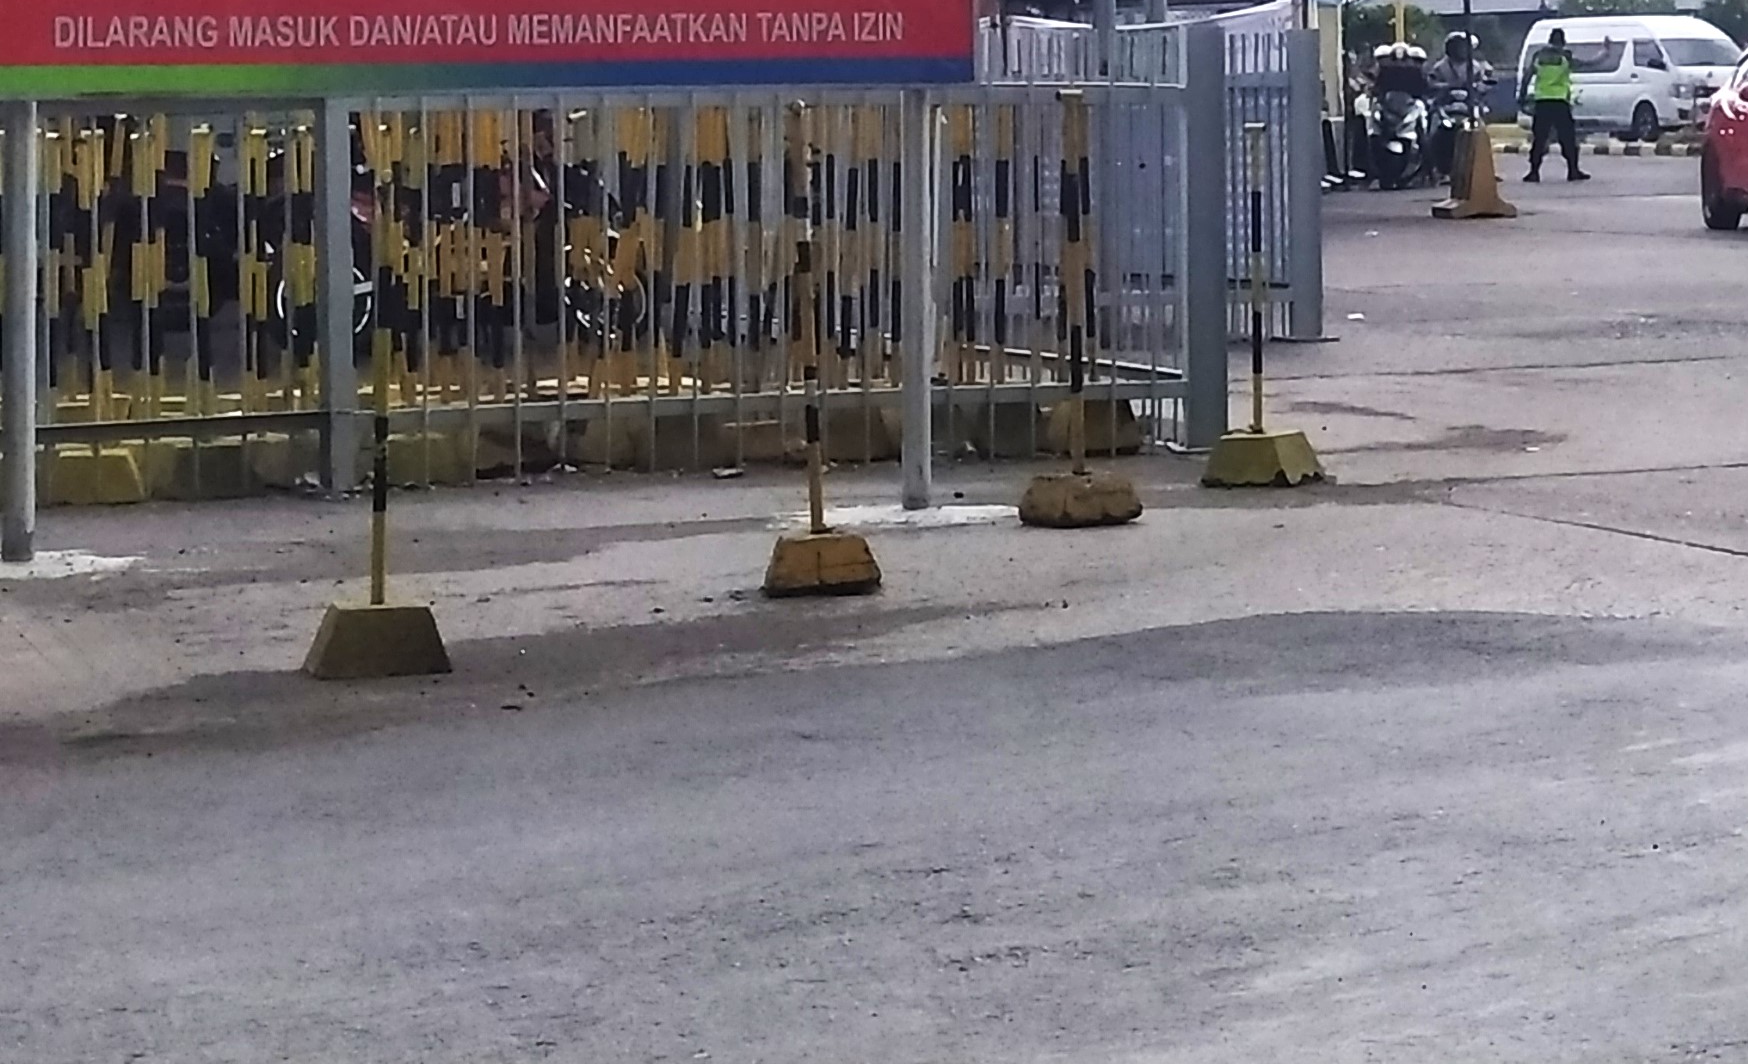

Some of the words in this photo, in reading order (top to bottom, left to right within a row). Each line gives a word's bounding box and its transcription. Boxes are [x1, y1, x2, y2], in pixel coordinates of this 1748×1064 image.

[55, 16, 218, 47] DILARANG
[230, 16, 339, 47] MASUK
[350, 15, 496, 45] DAN/ATAU
[508, 13, 746, 44] MEMANFAATKAN
[756, 12, 846, 41] TANPA
[854, 12, 902, 41] IZIN
